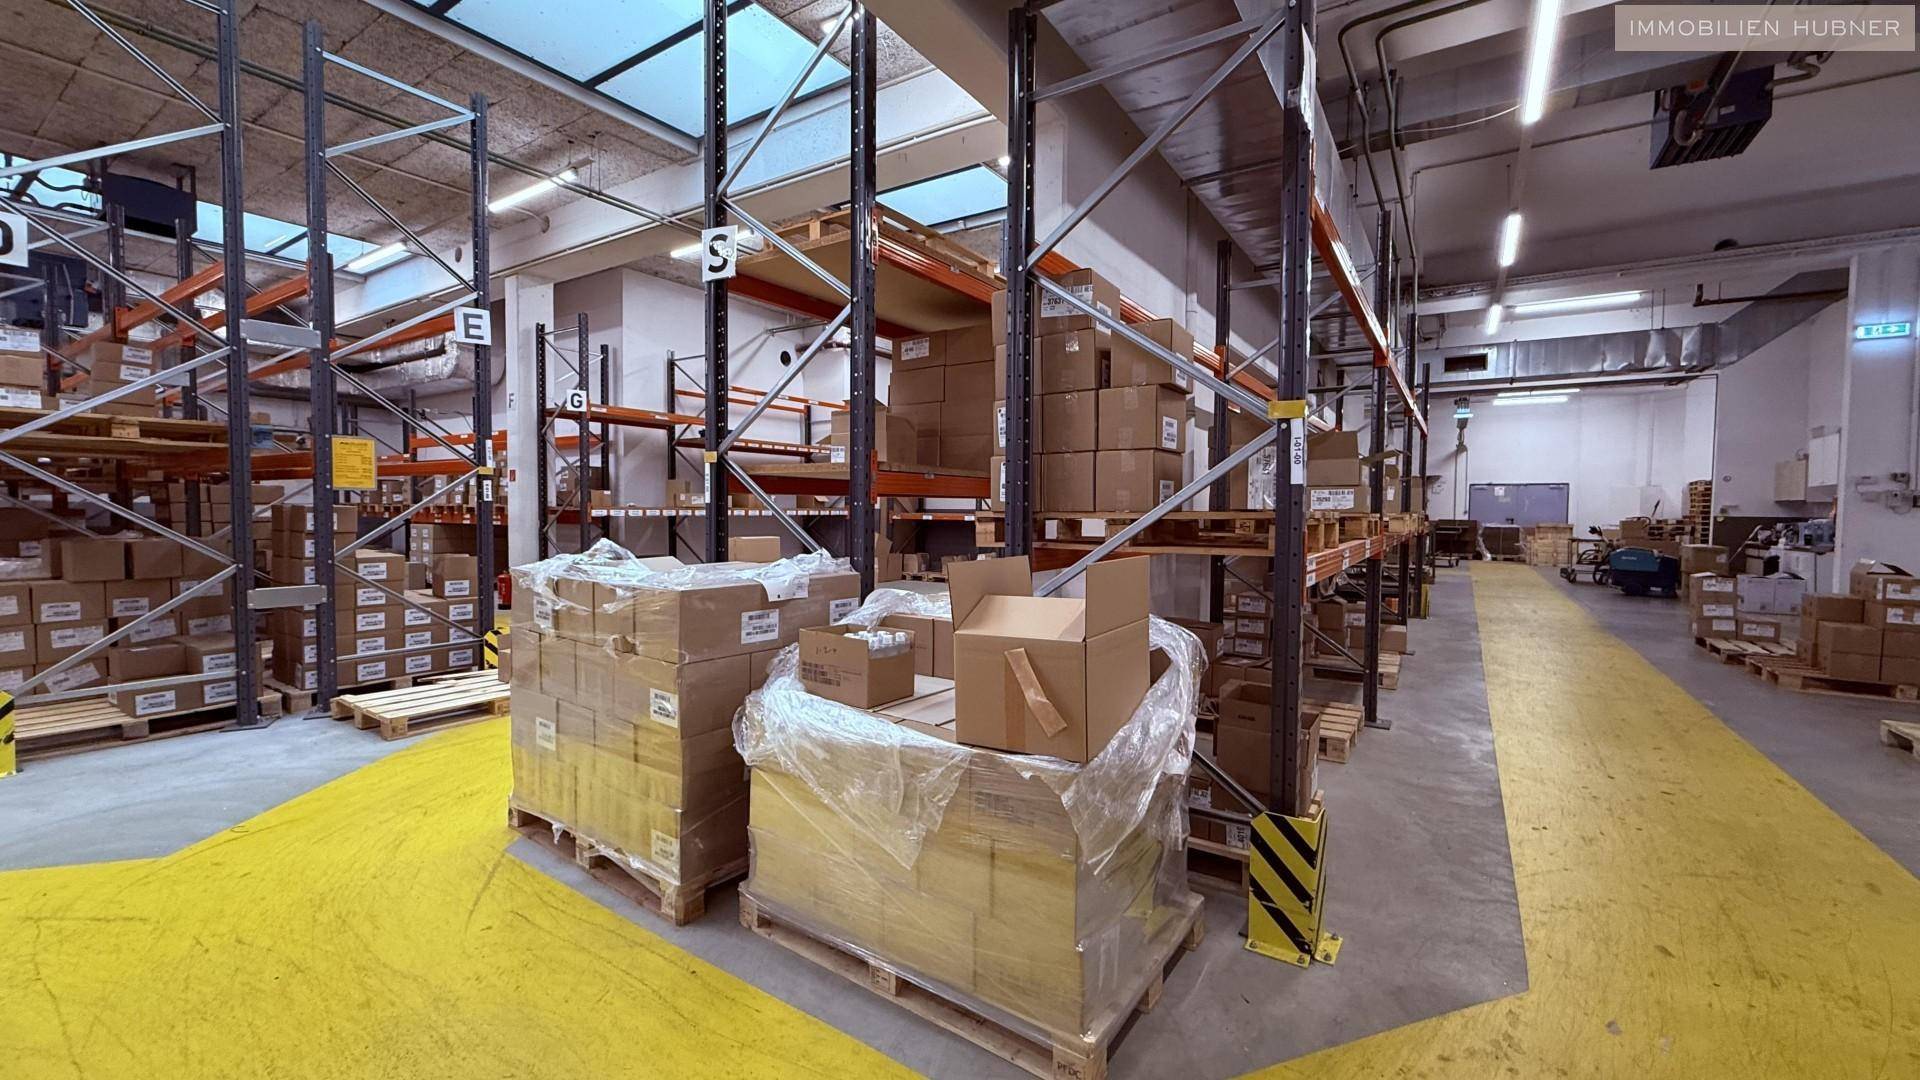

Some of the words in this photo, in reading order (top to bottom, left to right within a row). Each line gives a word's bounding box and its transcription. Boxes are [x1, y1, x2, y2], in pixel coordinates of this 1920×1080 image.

[708, 233, 729, 273] S
[463, 313, 484, 340] E
[570, 393, 583, 409] G
